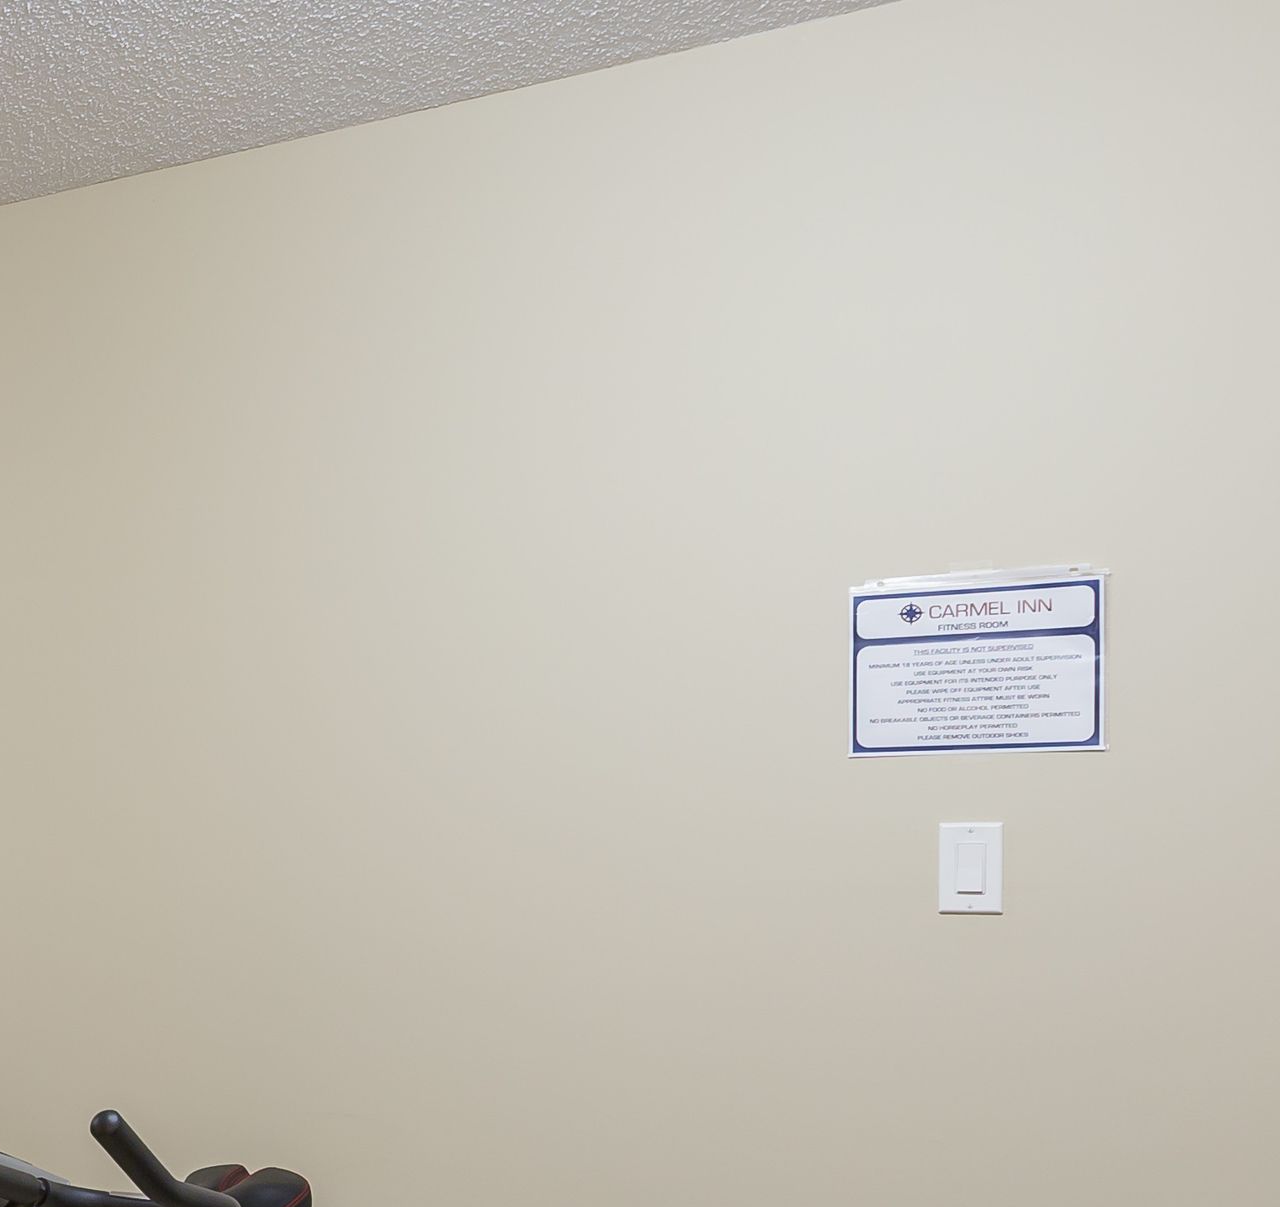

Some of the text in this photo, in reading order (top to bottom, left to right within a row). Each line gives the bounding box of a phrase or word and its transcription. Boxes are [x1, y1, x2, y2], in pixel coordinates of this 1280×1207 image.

[929, 598, 1053, 619] CARMEL INN
[937, 620, 1009, 631] FITNESS ROOM
